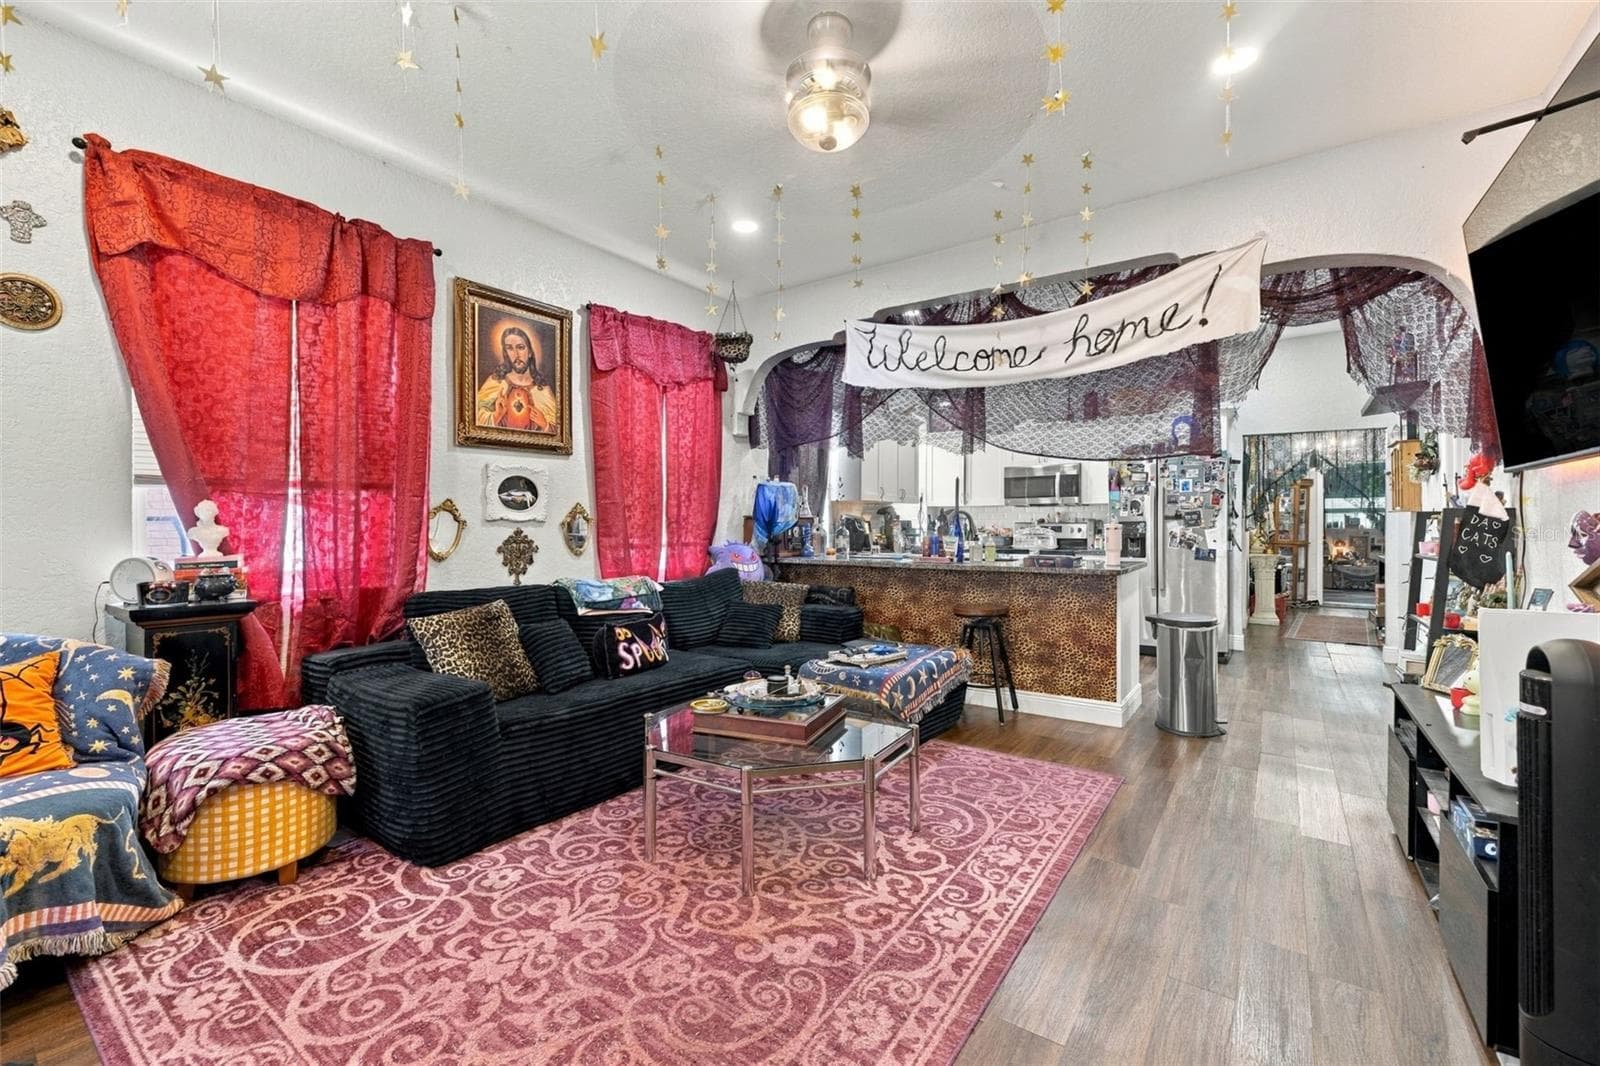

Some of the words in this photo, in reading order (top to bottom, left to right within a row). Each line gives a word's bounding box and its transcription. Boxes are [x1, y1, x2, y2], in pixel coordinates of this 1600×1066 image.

[854, 325, 1046, 373] Welcome
[1064, 264, 1222, 364] home!
[1470, 514, 1488, 528] DA
[1461, 527, 1499, 549] CATS
